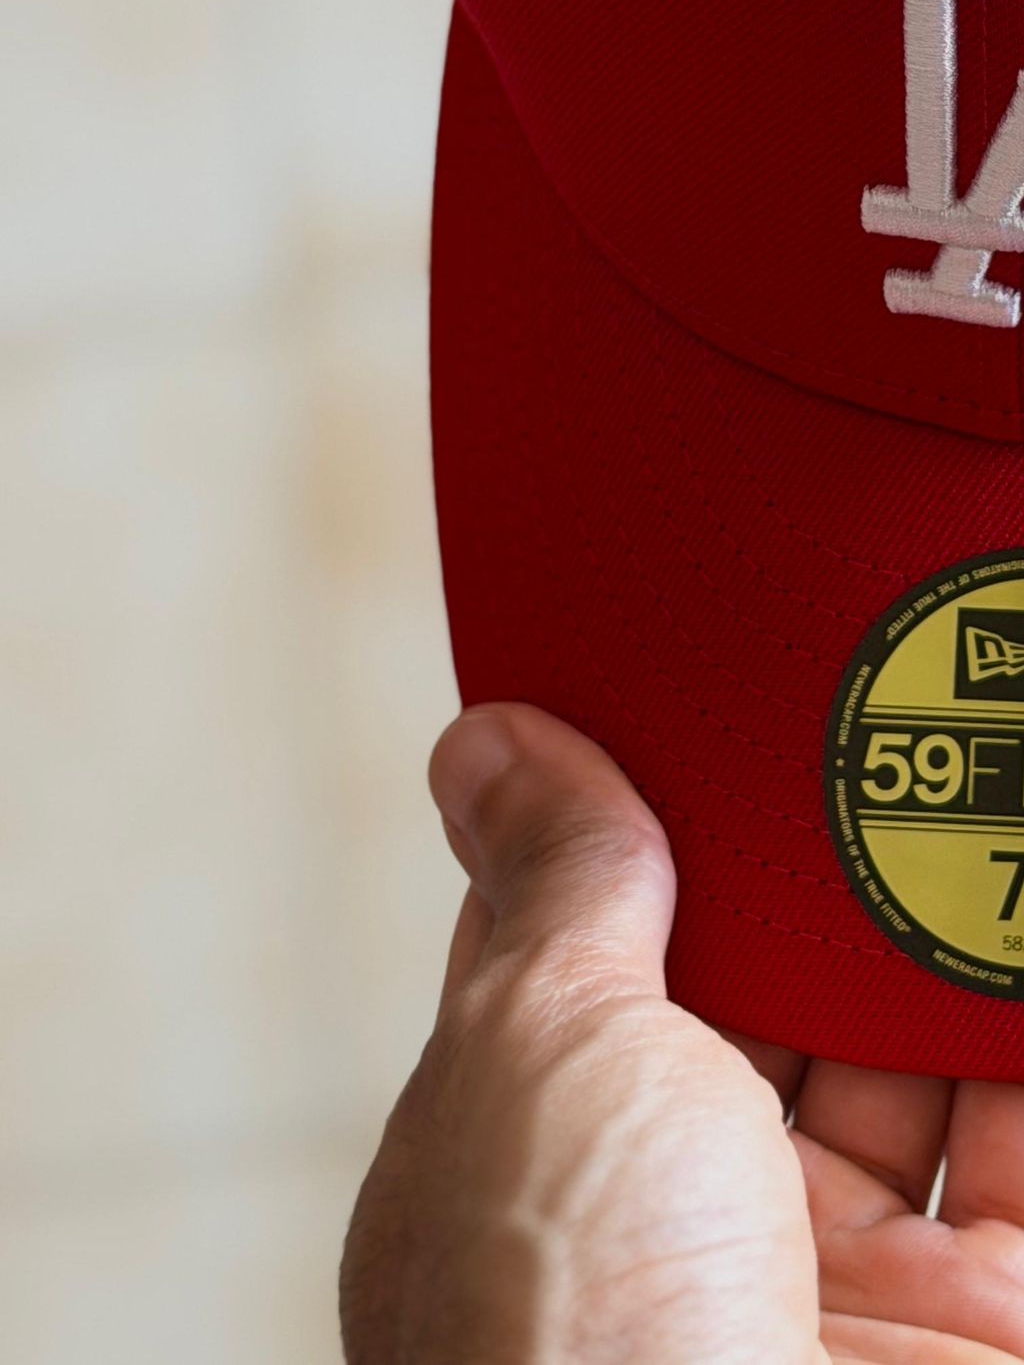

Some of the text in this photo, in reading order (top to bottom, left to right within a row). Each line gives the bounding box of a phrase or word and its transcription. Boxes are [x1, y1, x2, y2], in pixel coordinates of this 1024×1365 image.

[847, 844, 861, 857] OF
[853, 858, 870, 879] THE
[864, 878, 885, 904] TRUE
